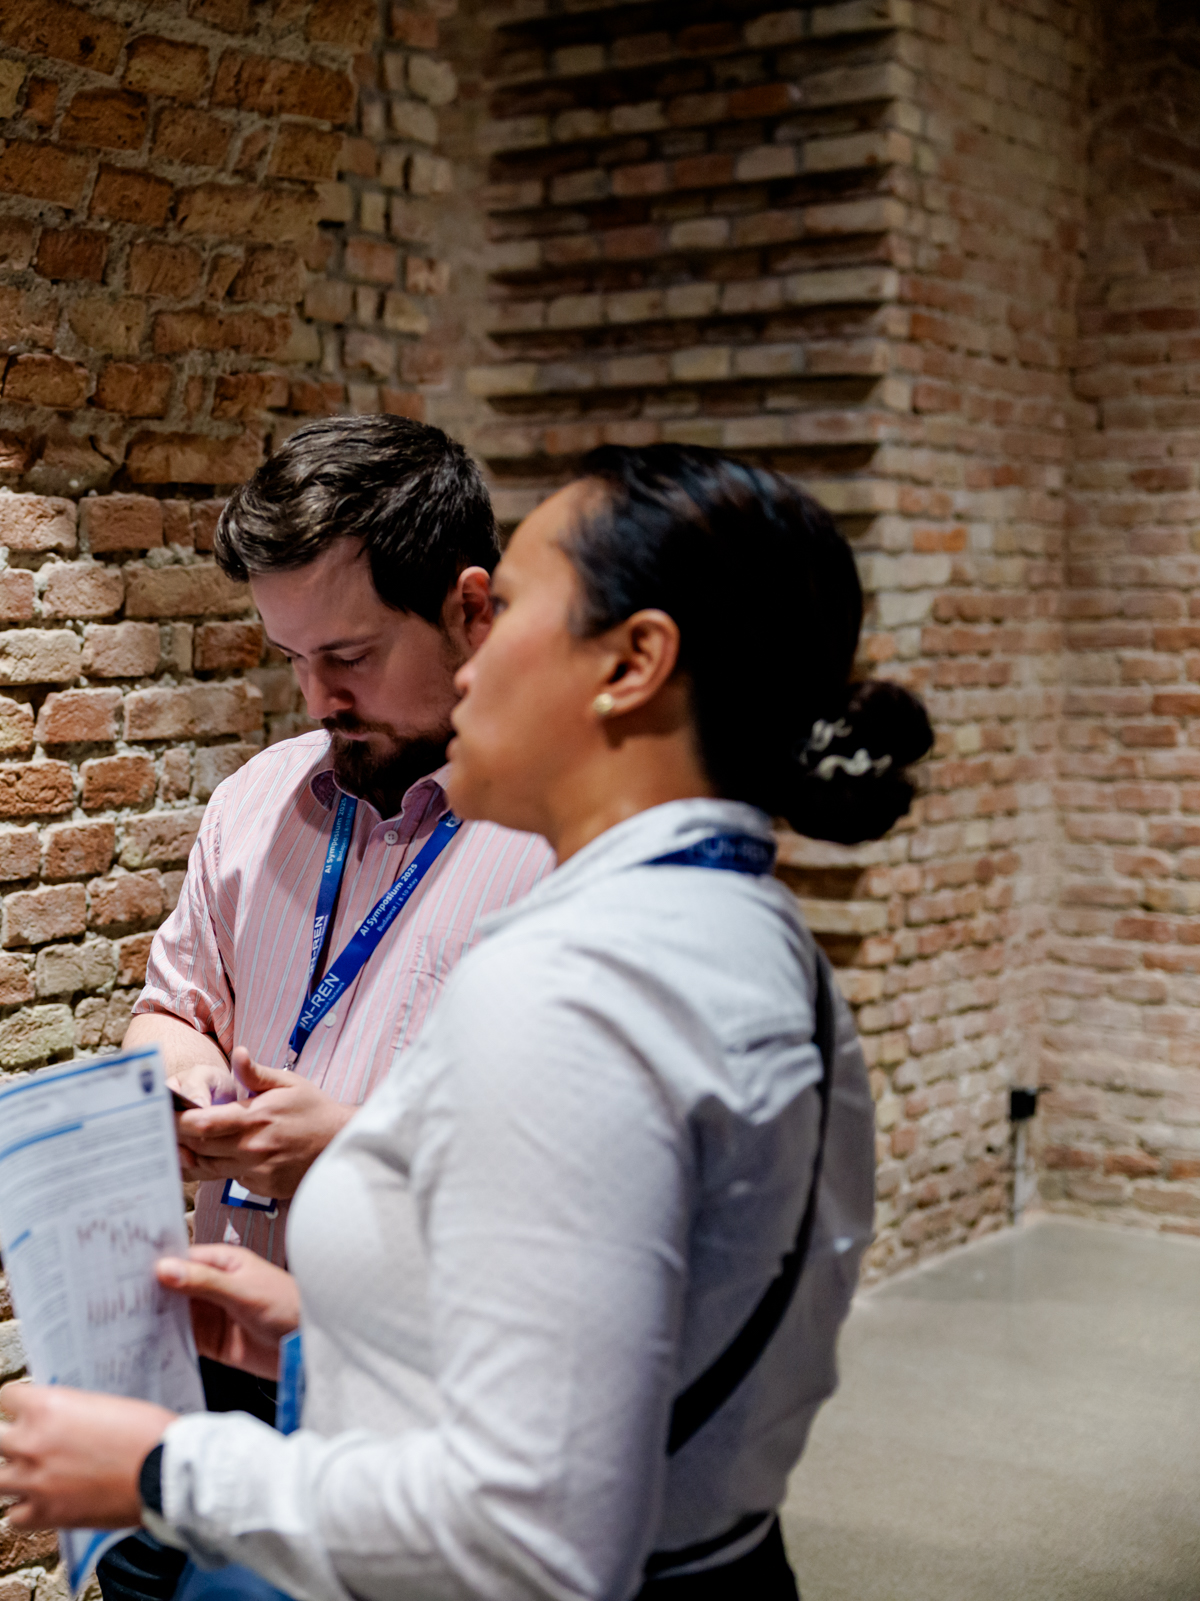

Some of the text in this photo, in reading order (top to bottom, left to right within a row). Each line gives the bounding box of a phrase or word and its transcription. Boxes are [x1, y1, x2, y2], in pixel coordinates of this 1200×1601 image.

[324, 797, 347, 873] AI Symposium 2025
[336, 836, 347, 862] Budapest
[359, 862, 418, 936] AI Symposium 2025
[375, 905, 398, 932] Budapest
[406, 877, 418, 890] May
